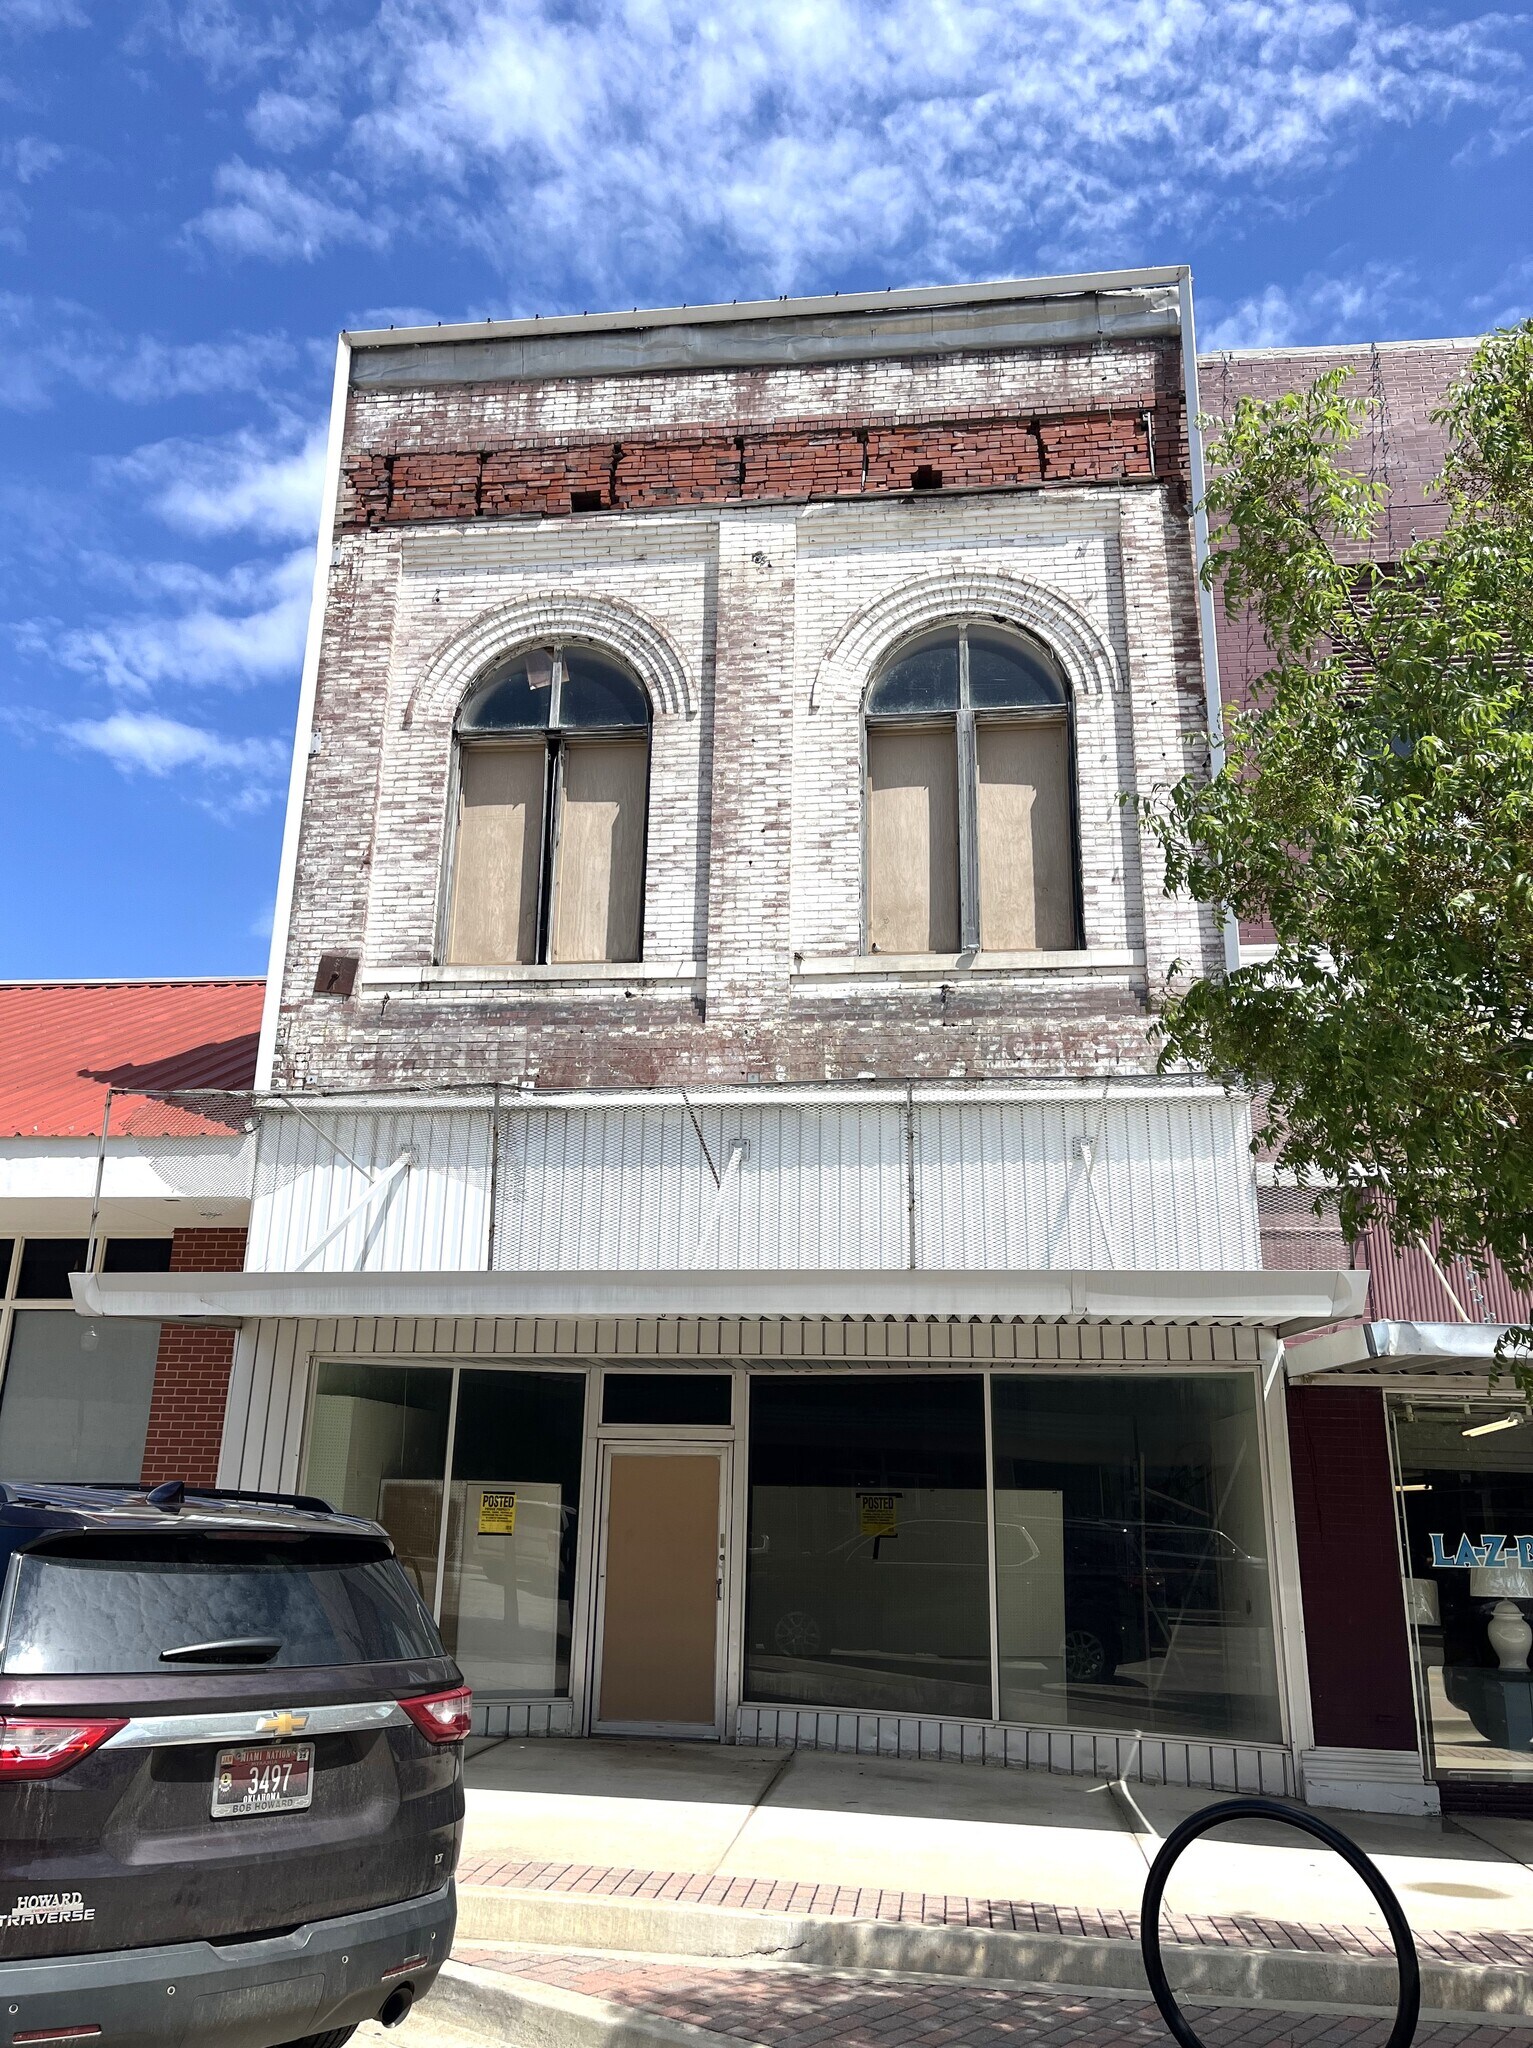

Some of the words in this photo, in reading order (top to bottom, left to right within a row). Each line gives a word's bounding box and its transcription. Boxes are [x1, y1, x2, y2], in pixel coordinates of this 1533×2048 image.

[482, 1495, 514, 1508] POSTED
[862, 1497, 894, 1510] POSTED
[247, 1763, 293, 1795] 3497
[243, 1792, 280, 1803] OKLAHOMA
[232, 1804, 252, 1813] BOB
[254, 1799, 293, 1811] HOWARD
[17, 1892, 82, 1909] HOWARD
